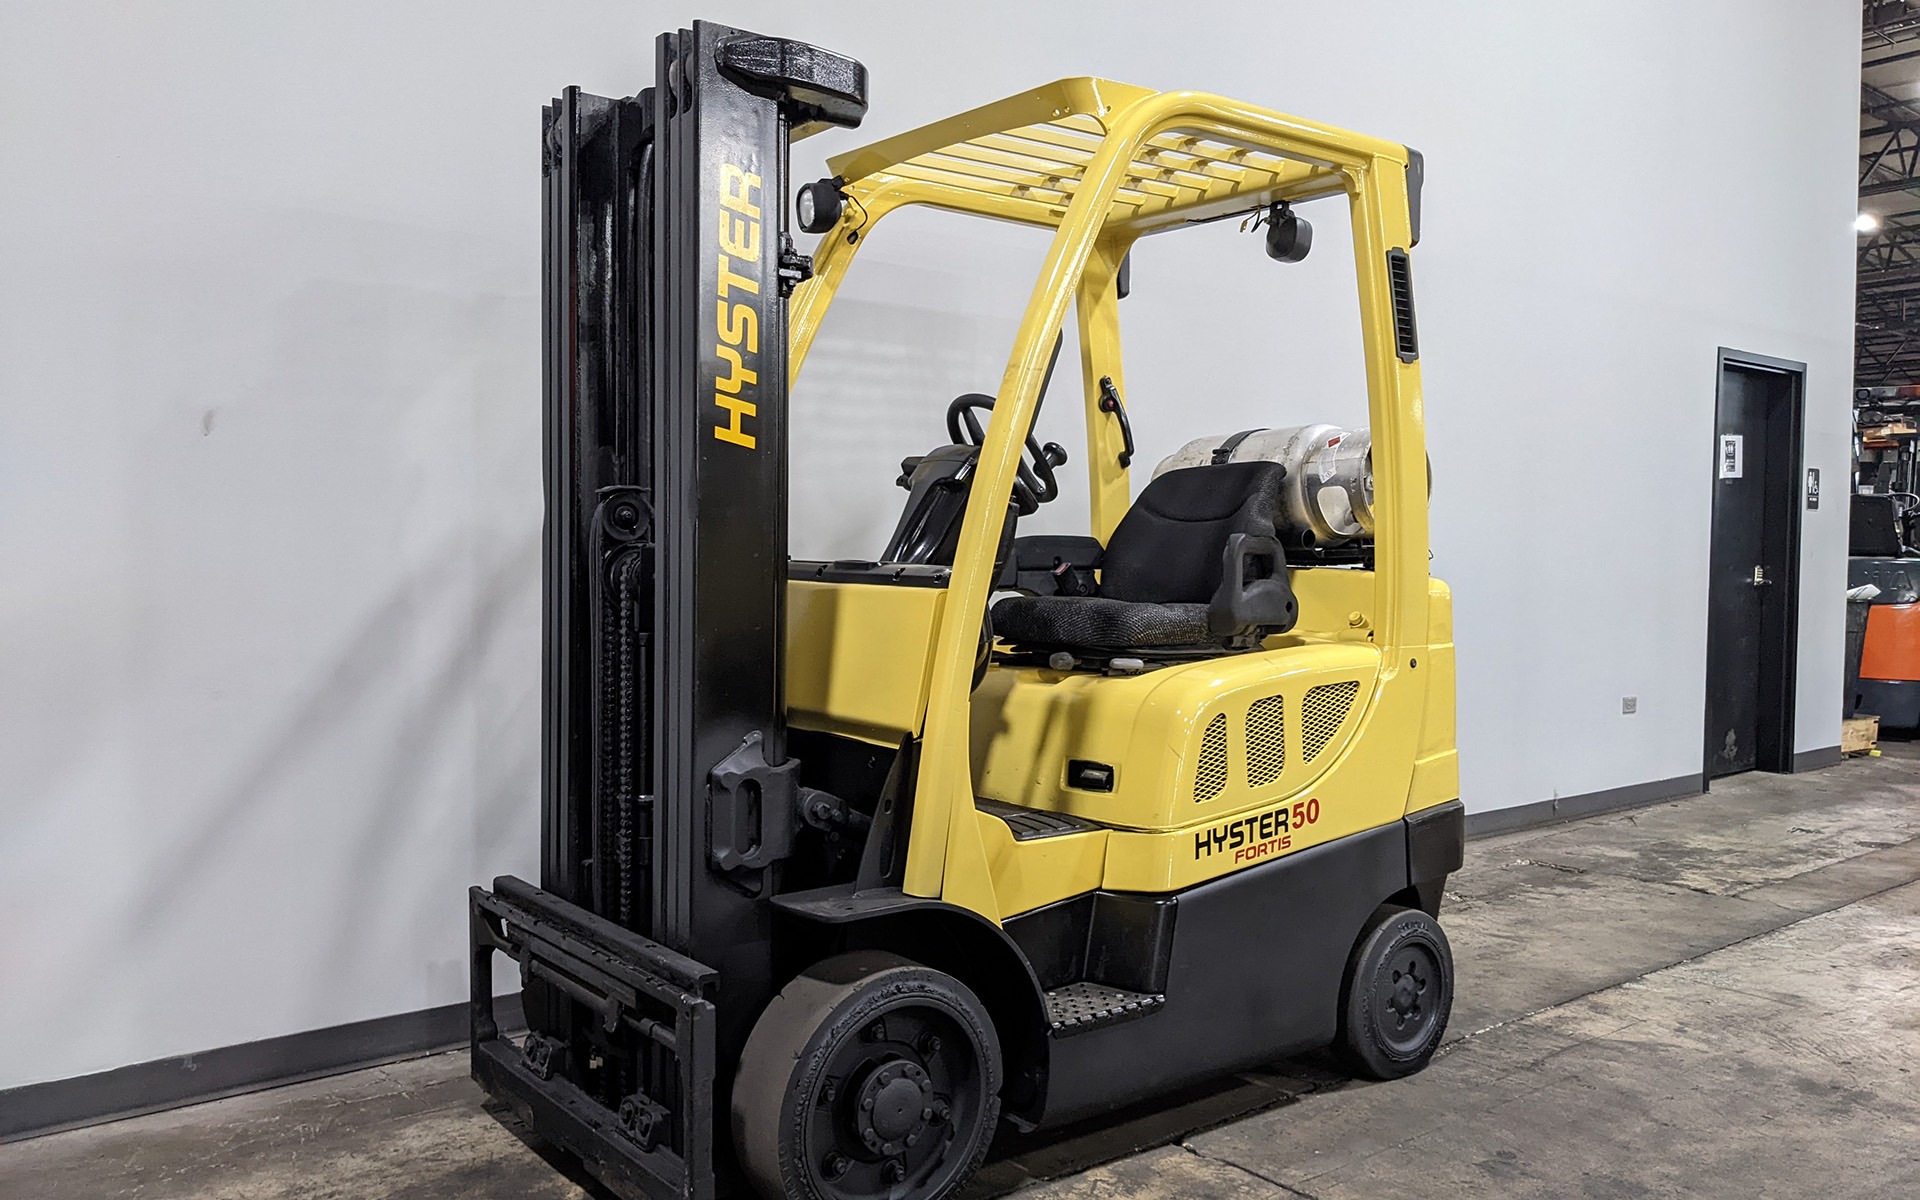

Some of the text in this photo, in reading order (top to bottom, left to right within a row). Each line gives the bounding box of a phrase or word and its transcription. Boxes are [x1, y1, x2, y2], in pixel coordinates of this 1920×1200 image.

[714, 162, 762, 450] HYSTER
[1195, 798, 1319, 860] HYSTER 50
[1235, 835, 1291, 864] FORTIS
